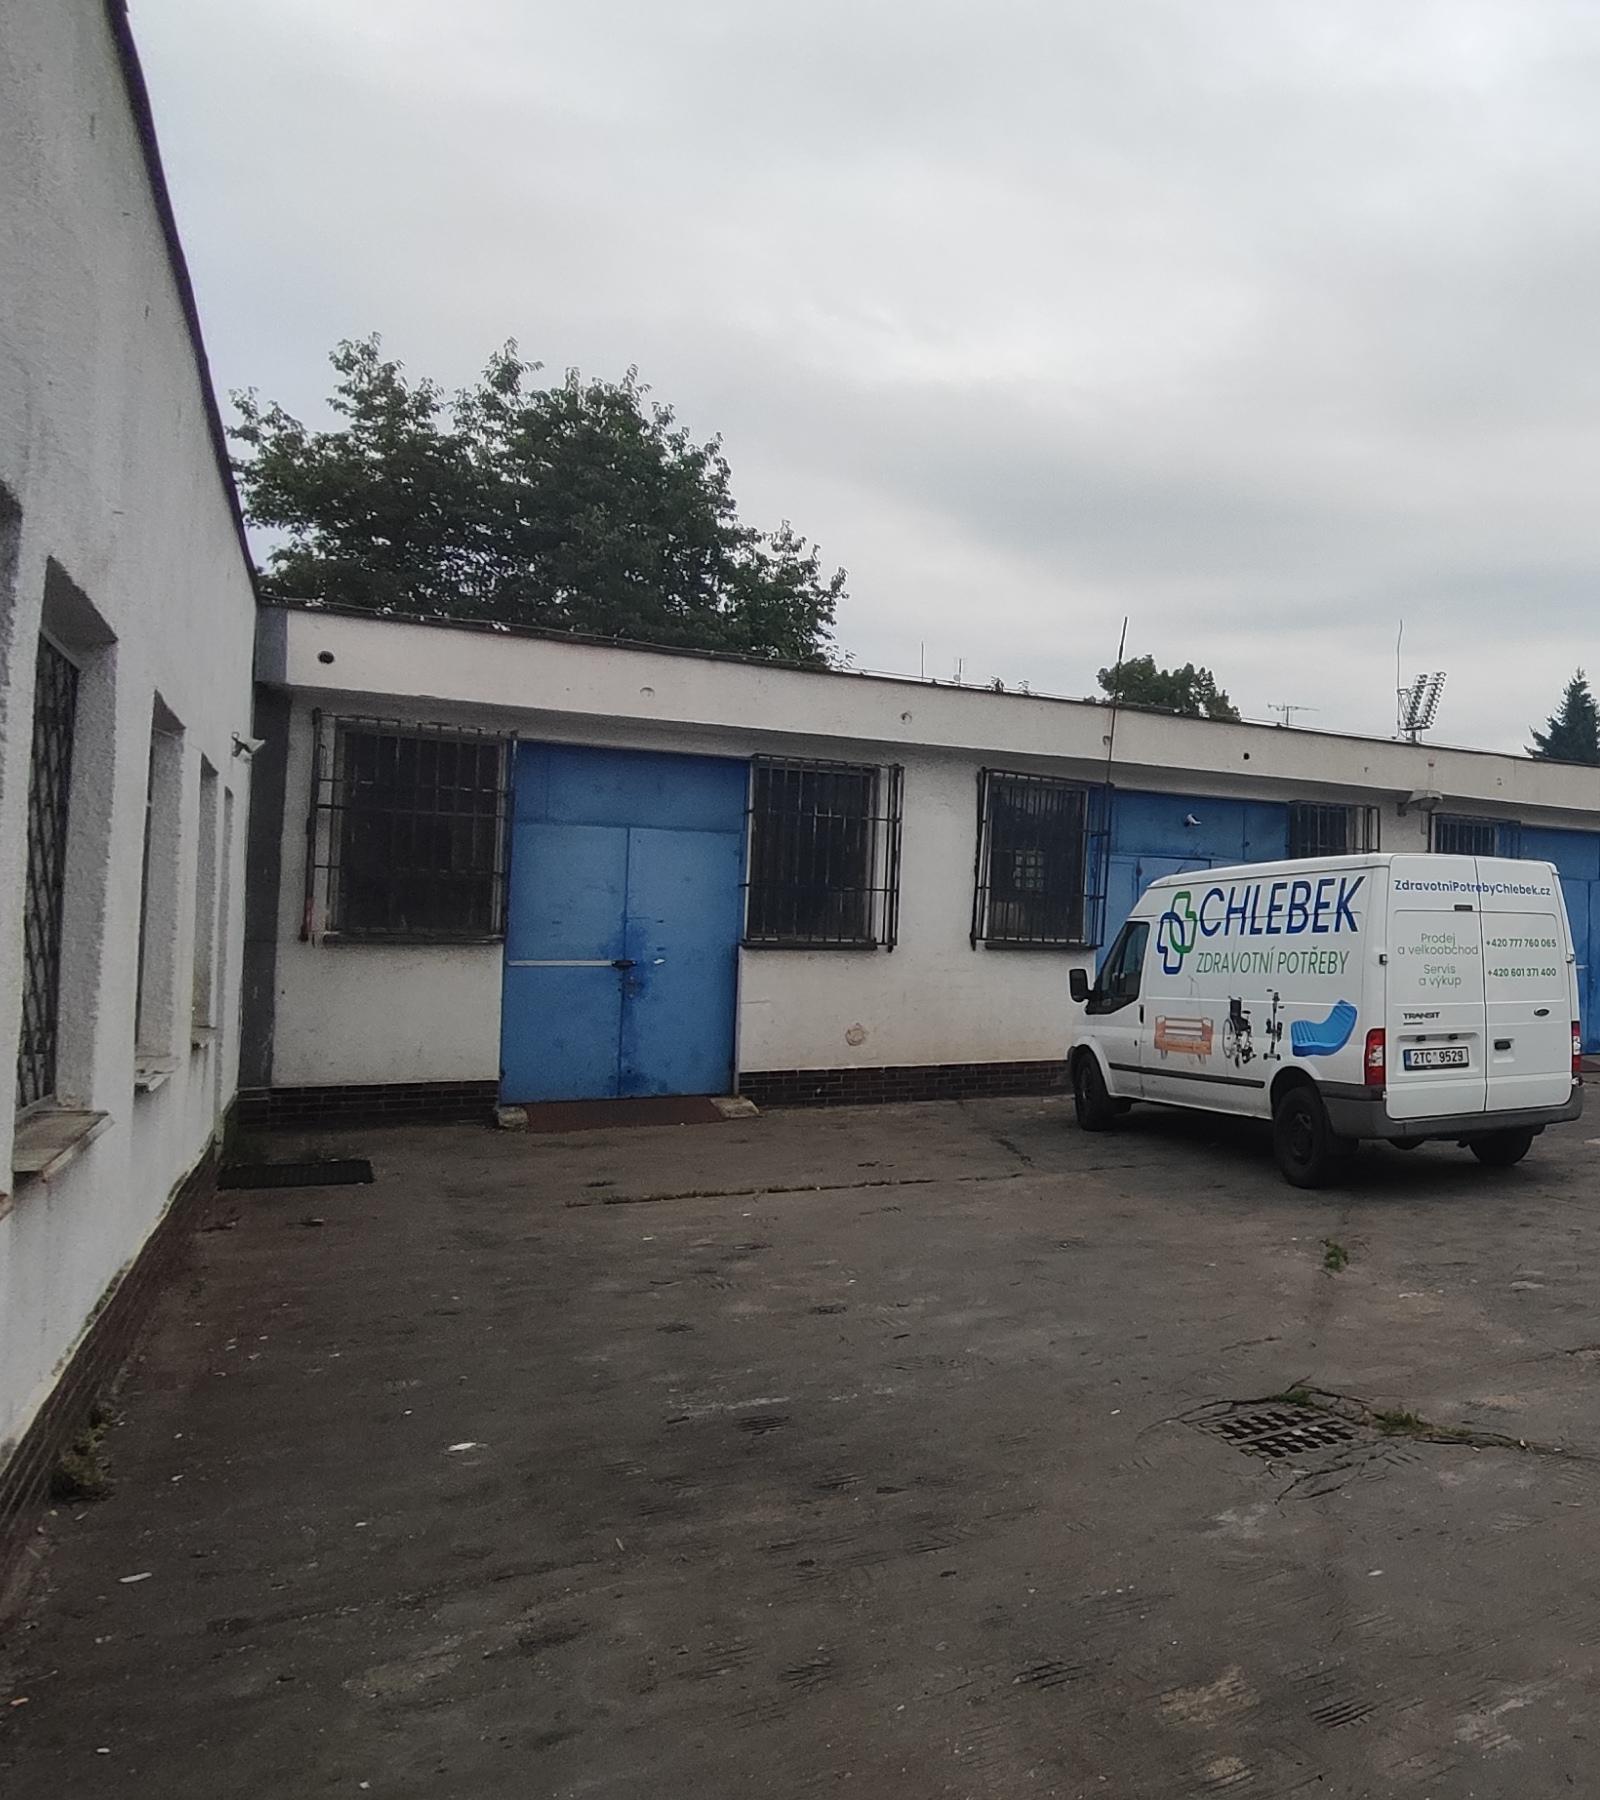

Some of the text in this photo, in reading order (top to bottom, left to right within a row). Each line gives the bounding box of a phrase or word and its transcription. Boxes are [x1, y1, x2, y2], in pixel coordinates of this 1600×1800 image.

[1394, 880, 1551, 896] ZdravotniPotrebyChlebek.cz
[1200, 876, 1366, 937] CHLEBEK
[1421, 933, 1456, 948] Prodej
[1486, 938, 1557, 947] +420 777 760 065
[1398, 945, 1478, 955] a velkoobchod
[1196, 946, 1350, 975] ZDRAVOTNÍ POTŘEBY
[1424, 964, 1456, 975] Servis
[1488, 968, 1557, 977] +420 601 371 400
[1419, 975, 1462, 988] a výkup
[1413, 1050, 1464, 1064] 2TC 9529
